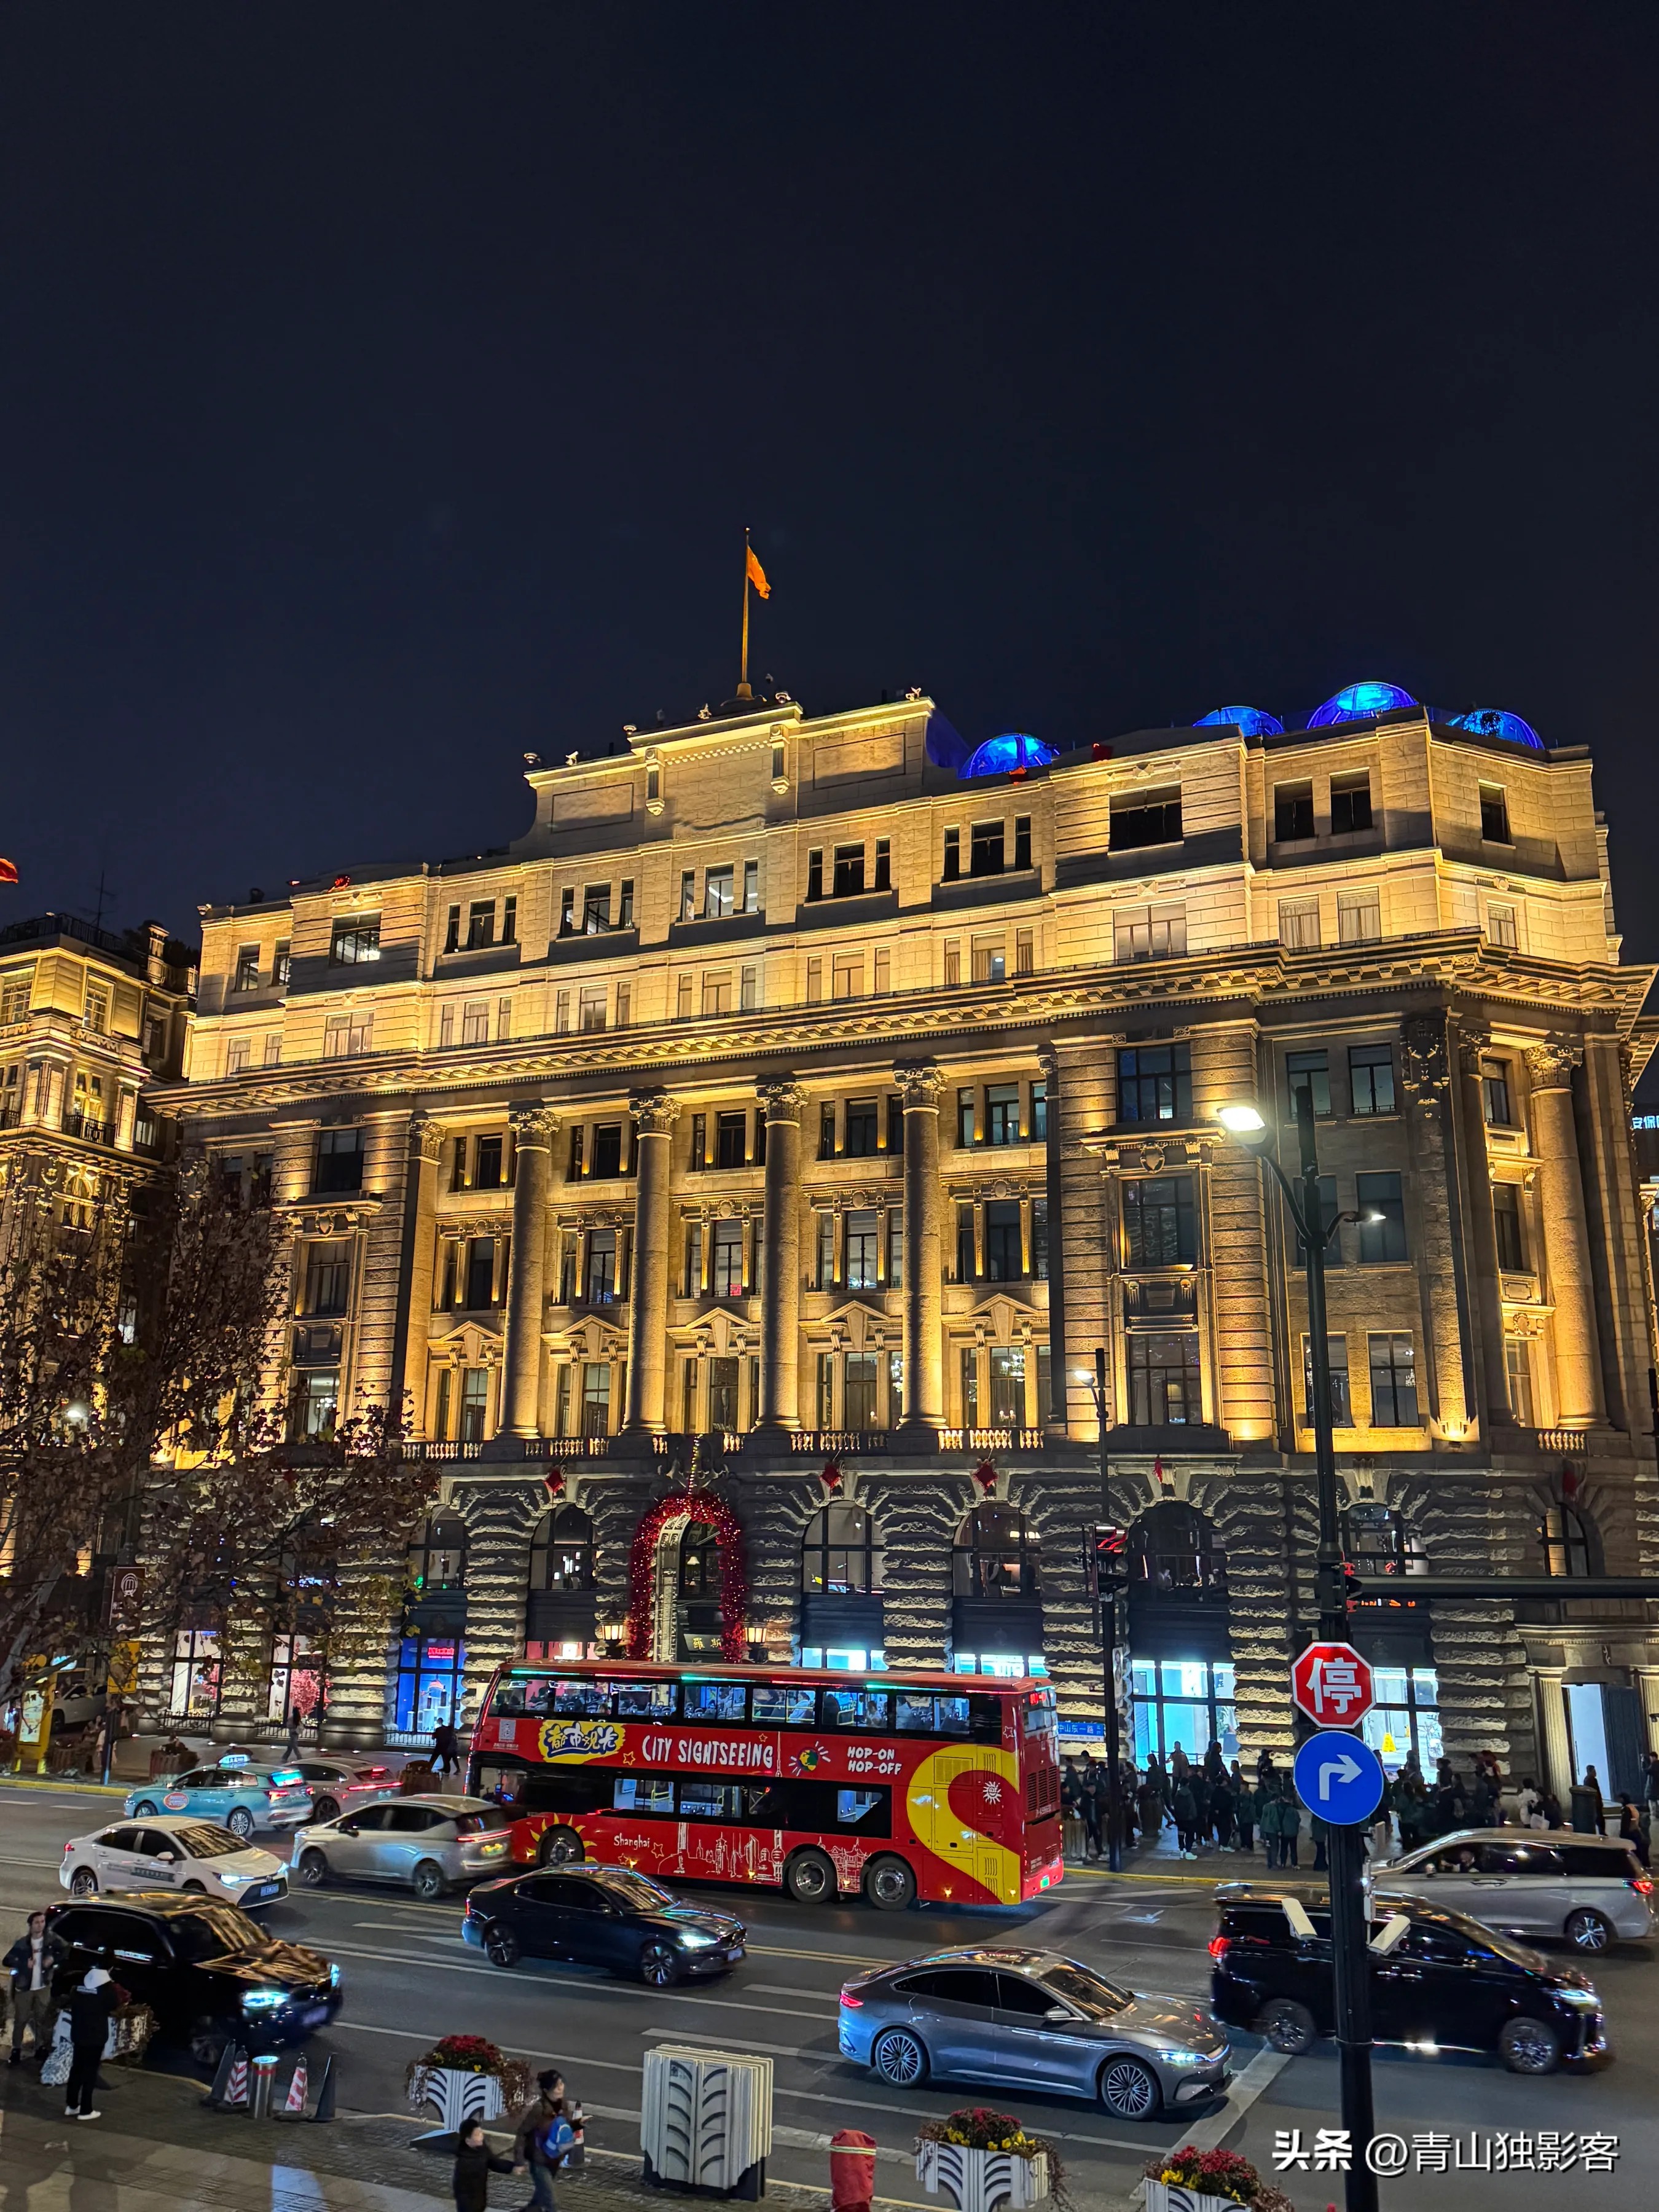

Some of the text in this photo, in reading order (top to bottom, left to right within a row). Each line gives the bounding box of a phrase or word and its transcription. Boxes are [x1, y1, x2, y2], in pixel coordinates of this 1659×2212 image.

[1306, 1657, 1362, 1714] 停
[547, 1721, 618, 1750] 都市观光
[1058, 1723, 1094, 1734] 中山东一路
[642, 1735, 774, 1769] CITY SIGHTSEEING
[847, 1746, 895, 1760] HOP-ON
[847, 1760, 902, 1775] HOP-OFF
[614, 1834, 650, 1849] Shanghai
